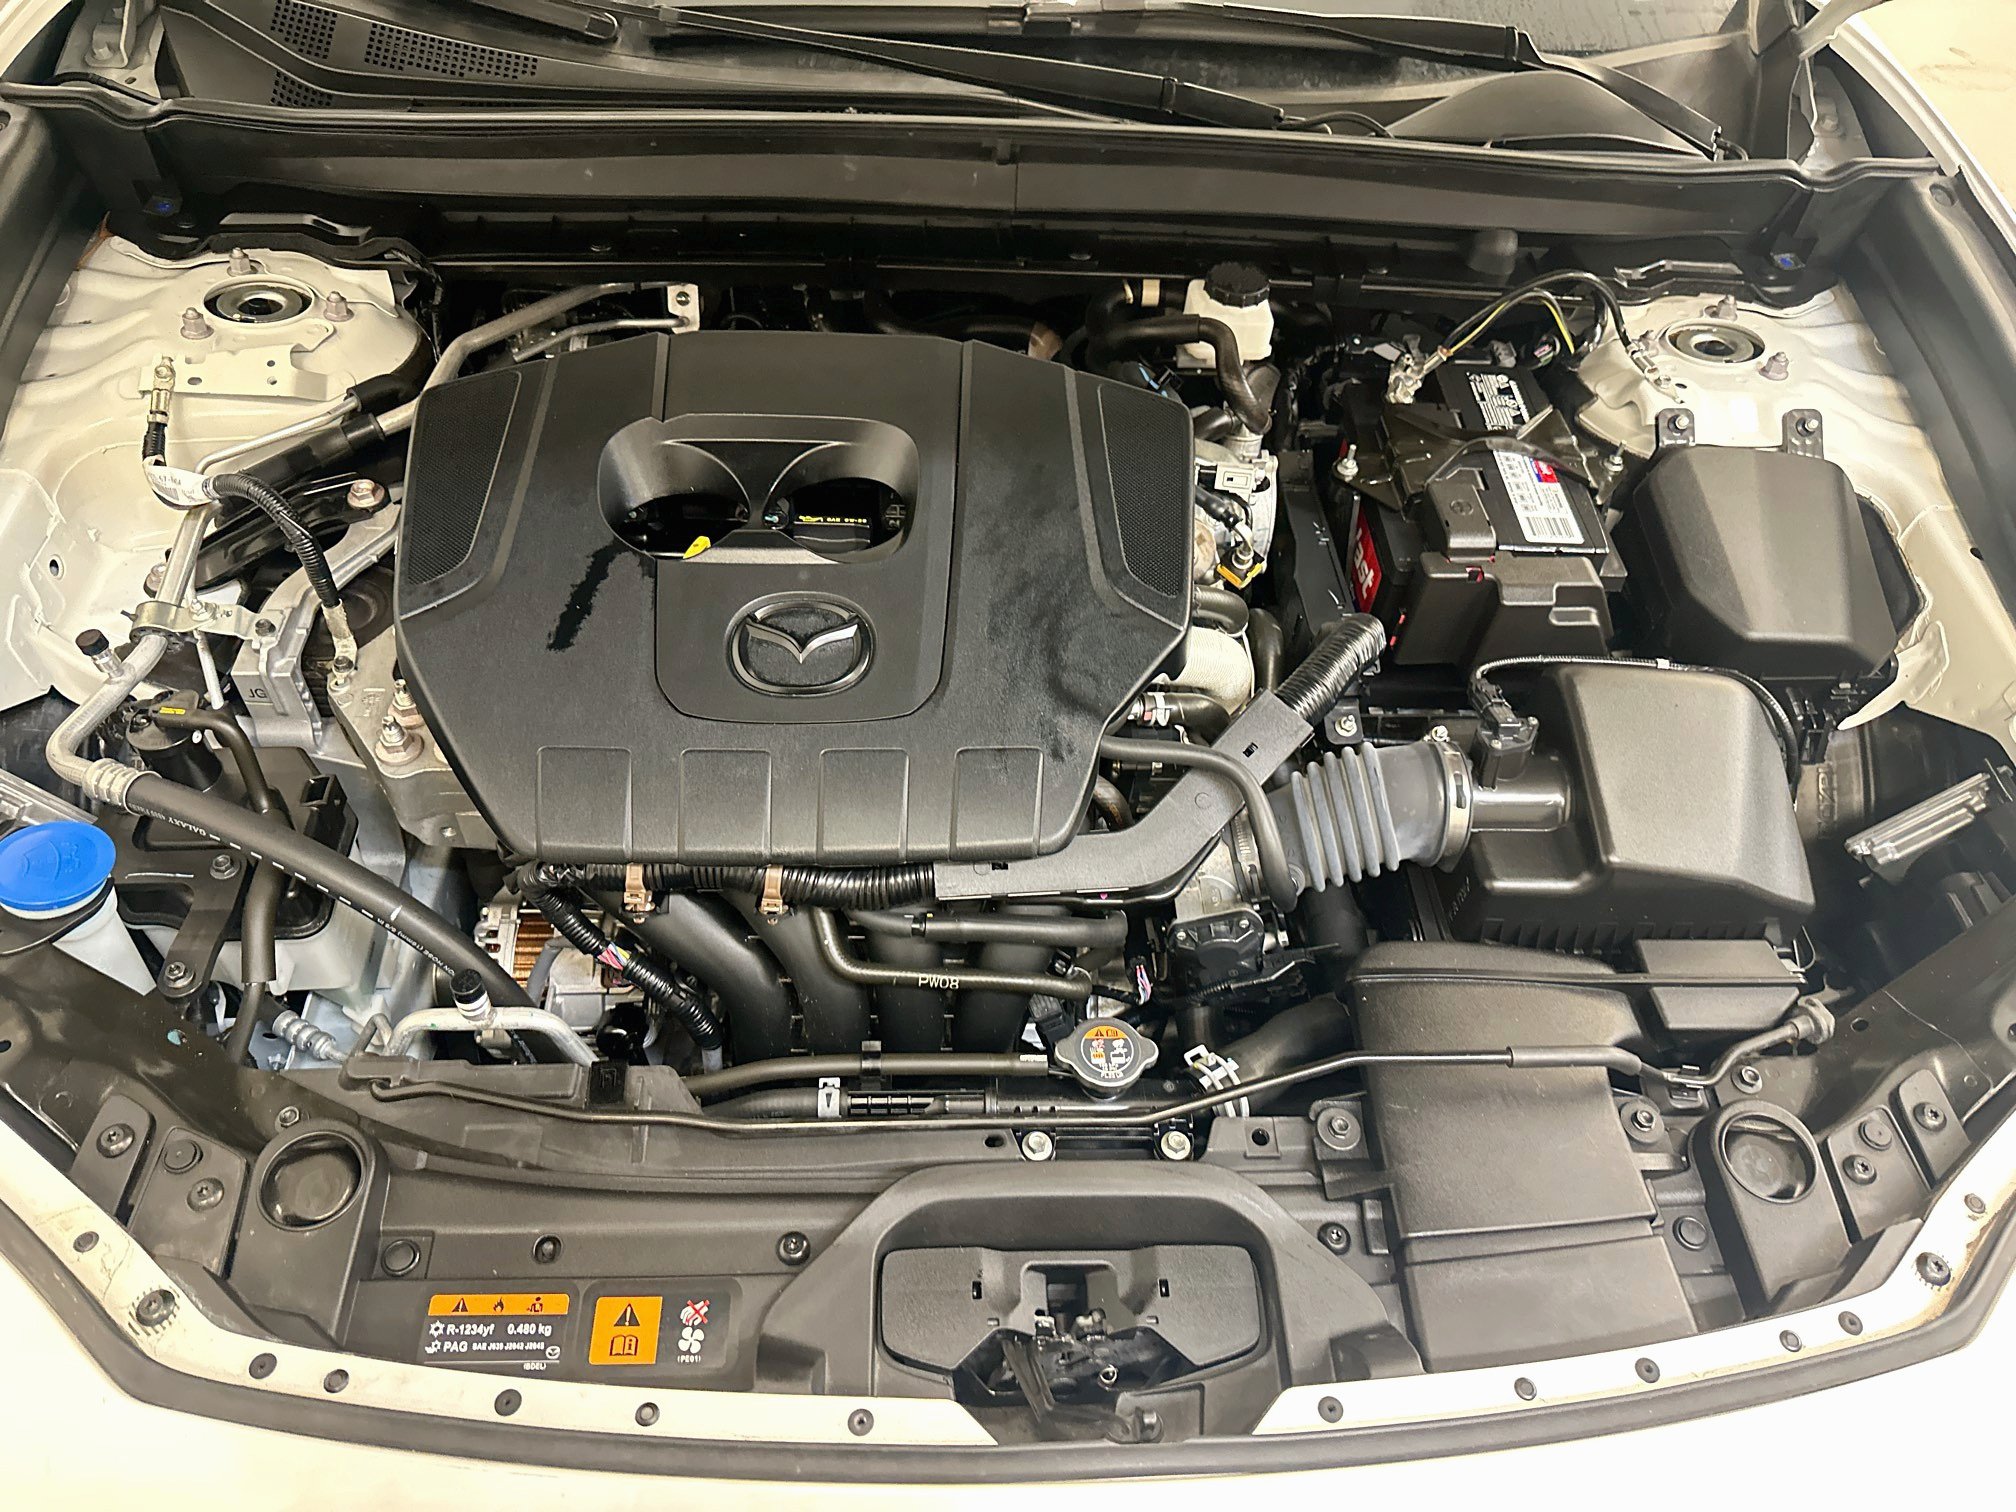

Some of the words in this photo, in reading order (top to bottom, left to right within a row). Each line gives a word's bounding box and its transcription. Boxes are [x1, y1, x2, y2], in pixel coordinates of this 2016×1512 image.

[249, 688, 267, 699] JG
[446, 1323, 495, 1337] R-1234yf
[538, 1323, 552, 1337] kg
[443, 1341, 468, 1353] PAG
